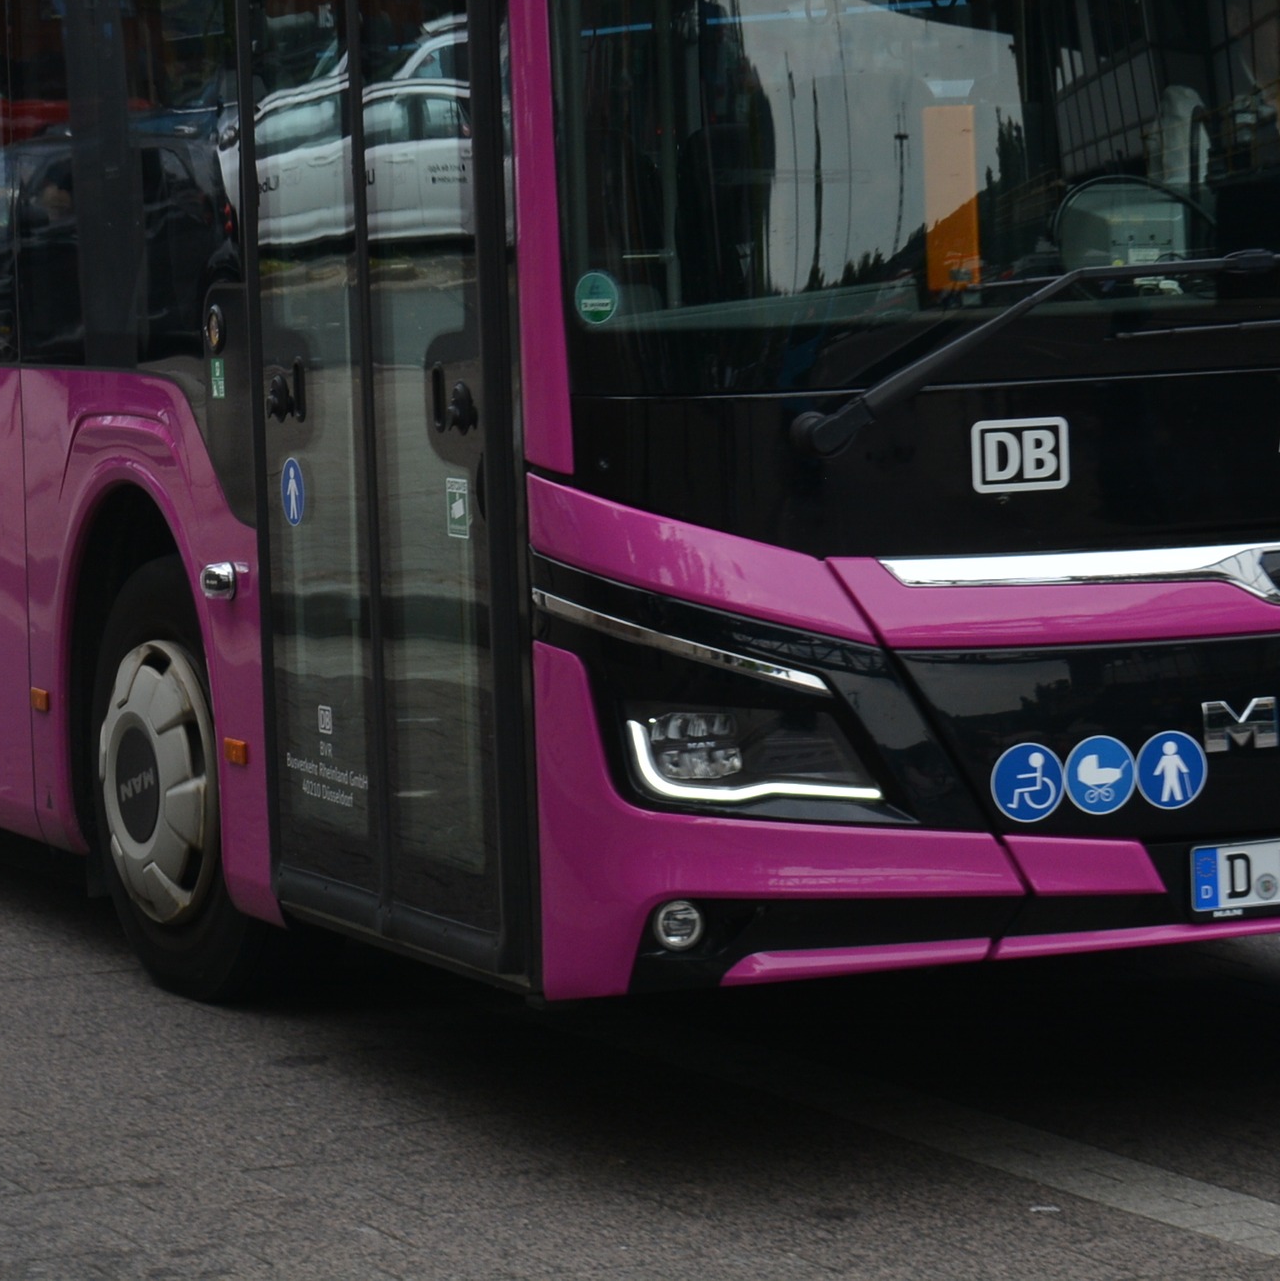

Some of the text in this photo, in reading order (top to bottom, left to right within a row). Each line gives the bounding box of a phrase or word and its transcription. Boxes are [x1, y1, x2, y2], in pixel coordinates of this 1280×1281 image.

[982, 427, 1060, 483] DB
[319, 708, 331, 731] DB
[120, 767, 155, 802] MAN
[286, 752, 318, 775] Busverkehr
[319, 762, 349, 785] Rheinland
[1200, 884, 1213, 900] D
[1225, 853, 1252, 900] D
